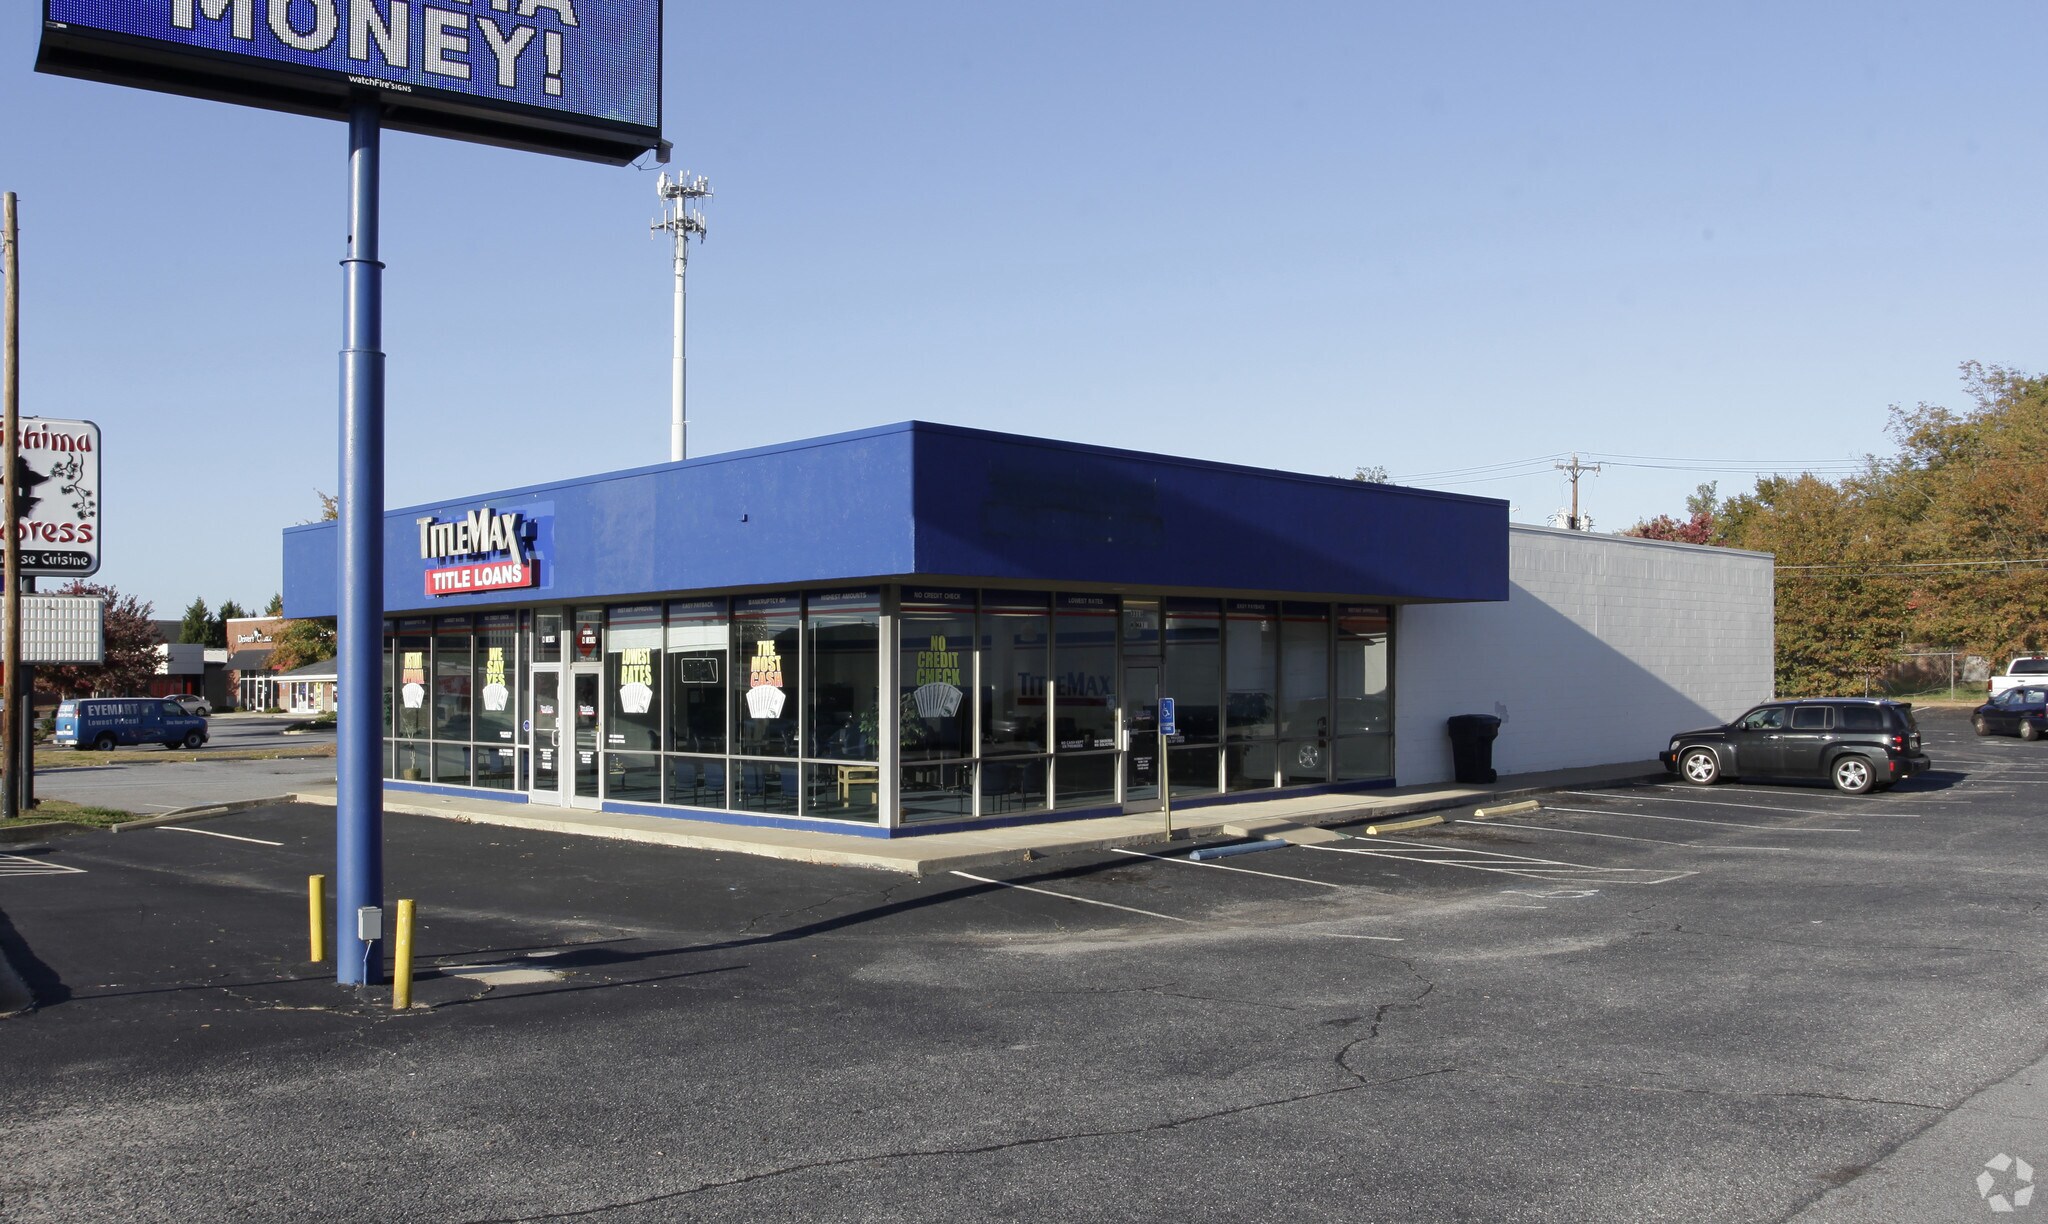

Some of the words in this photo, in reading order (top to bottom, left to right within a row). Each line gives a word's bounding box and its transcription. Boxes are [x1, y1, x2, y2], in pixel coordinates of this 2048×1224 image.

[42, 553, 88, 566] Cuisine
[432, 569, 471, 590] TITLE
[474, 563, 522, 586] LOANS
[757, 640, 776, 656] THE
[930, 635, 946, 651] NO
[488, 647, 503, 661] WE
[622, 648, 651, 665] LOWEST
[917, 651, 959, 668] CREDIT
[486, 661, 504, 674] SAY
[751, 655, 781, 672] MOST
[486, 673, 506, 687] YES
[621, 665, 652, 686] RATES
[750, 672, 783, 688] CASH
[916, 668, 961, 687] CHECK
[1018, 671, 1111, 696] TITEMAX
[87, 703, 138, 716] EYEMART
[88, 718, 112, 727] Lowest
